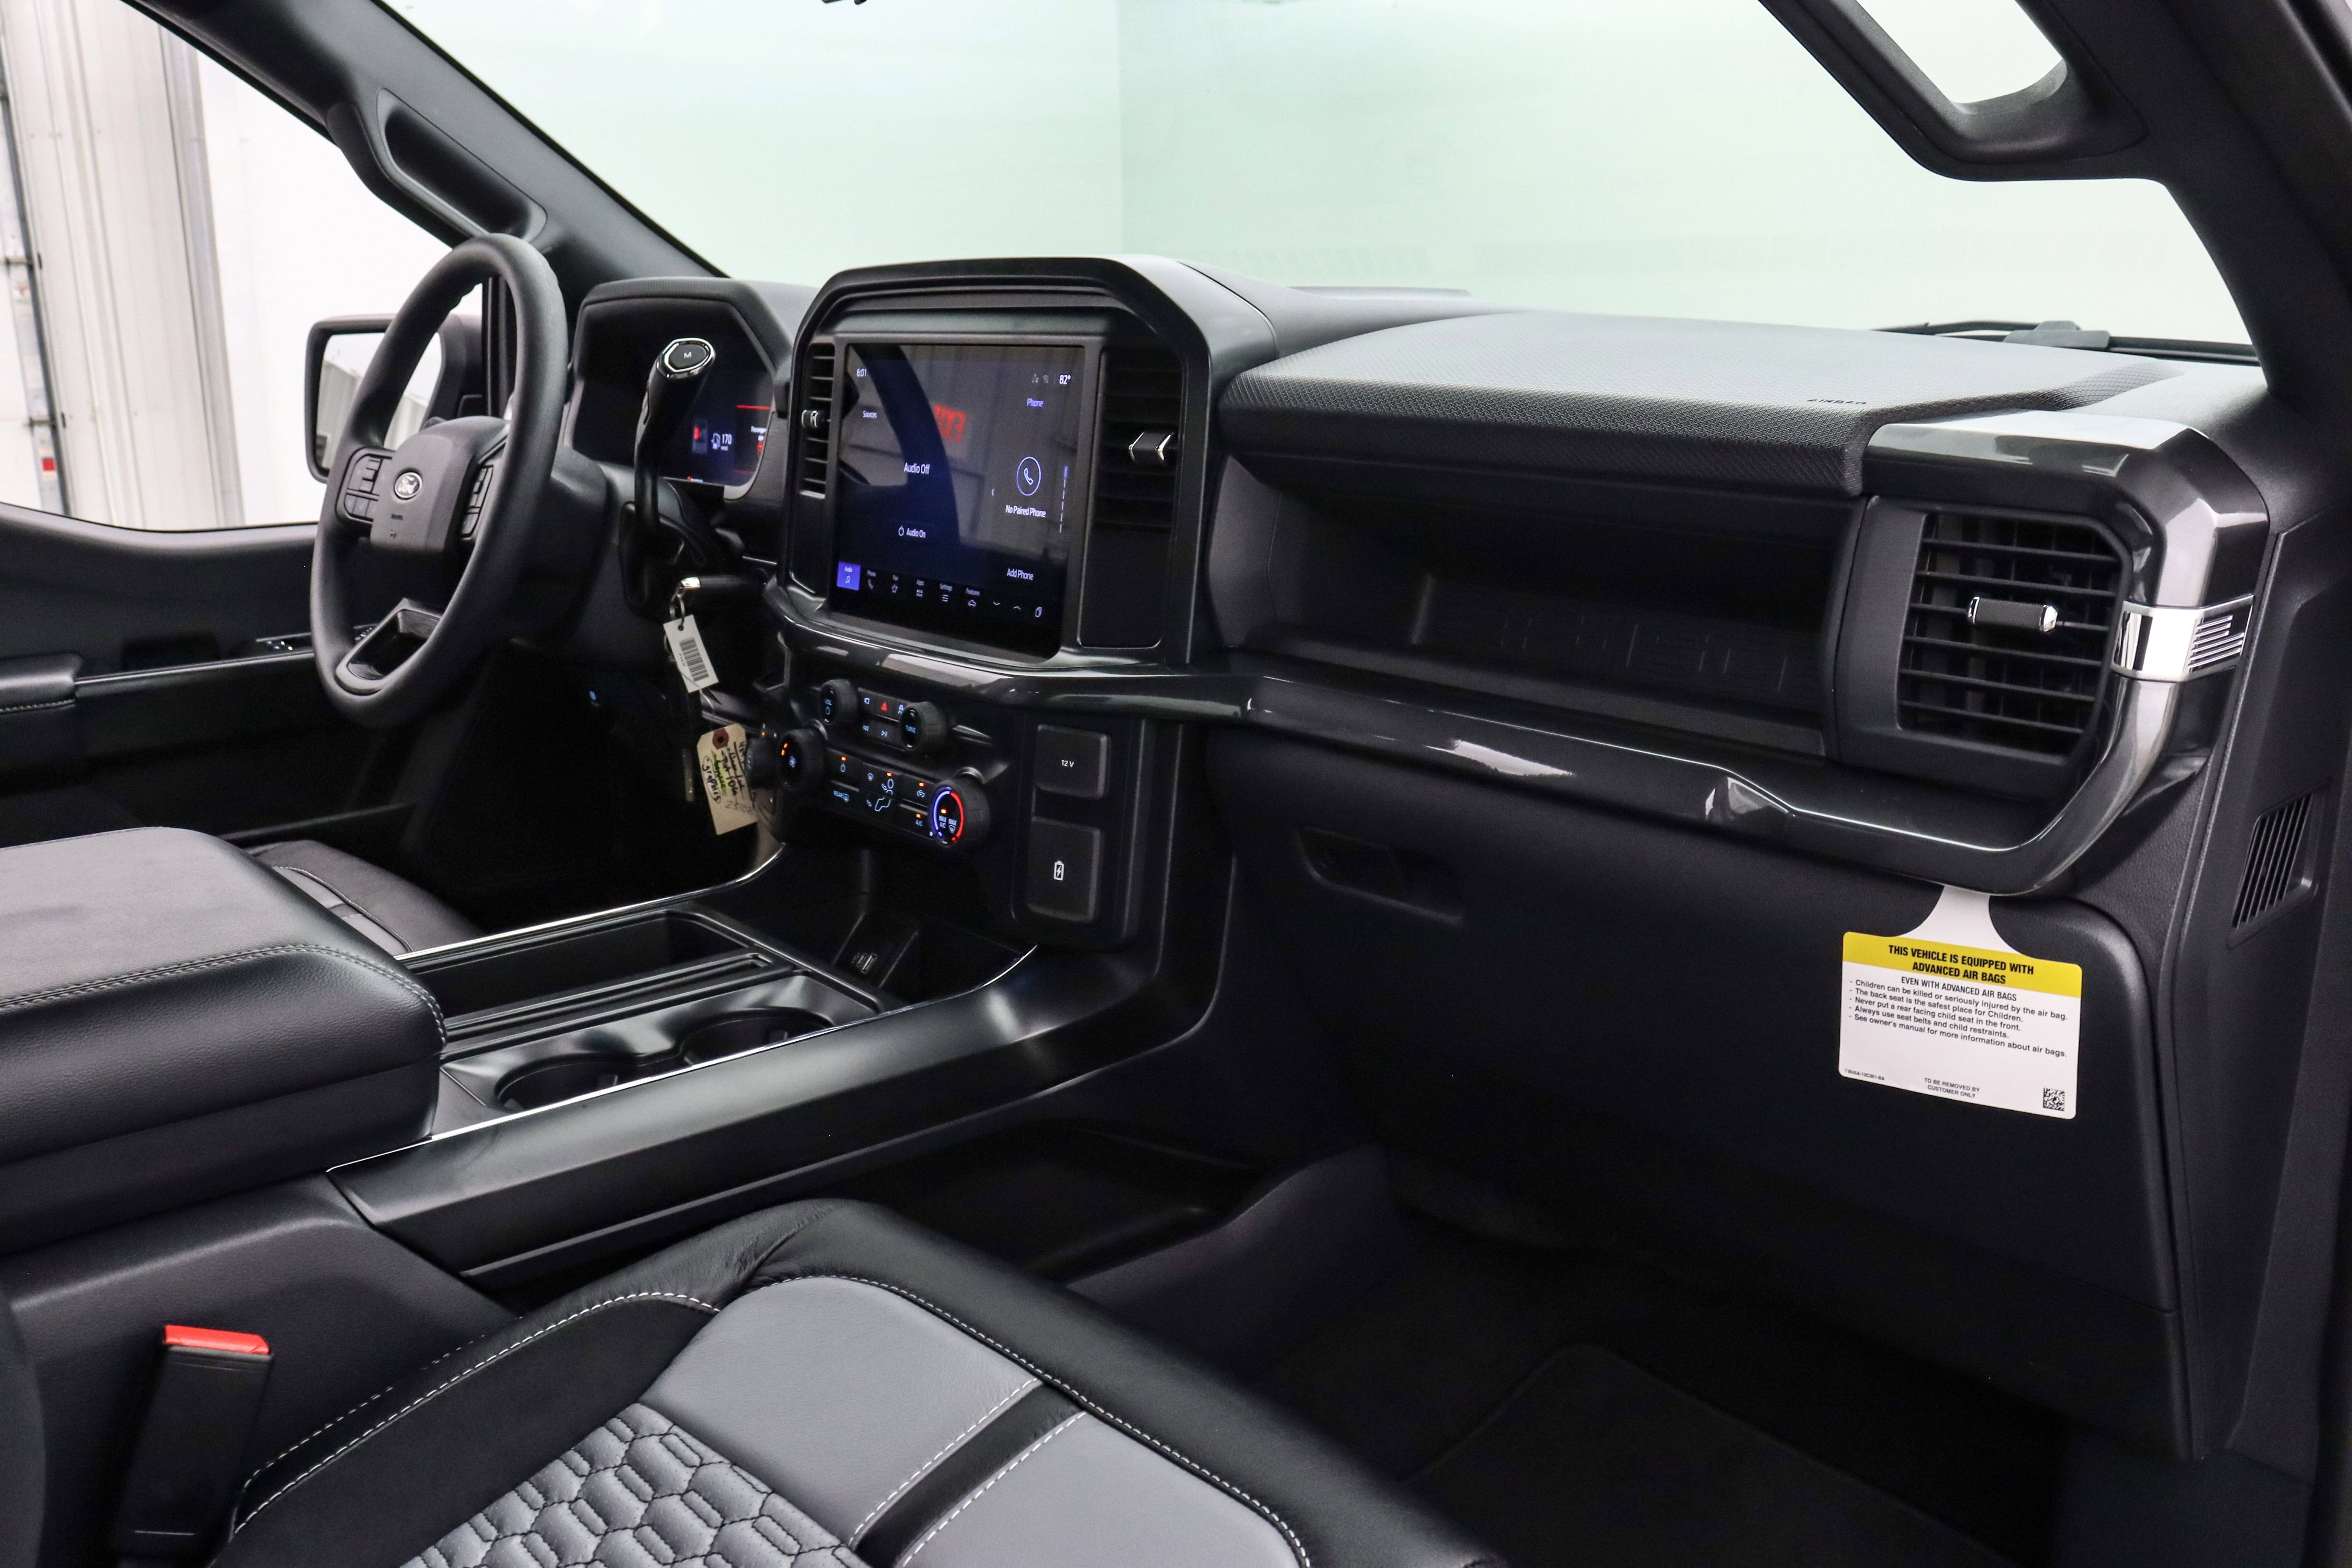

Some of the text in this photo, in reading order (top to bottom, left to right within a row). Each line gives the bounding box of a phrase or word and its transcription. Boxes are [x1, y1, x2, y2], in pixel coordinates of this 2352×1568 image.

[1027, 398, 1044, 407] Phone
[722, 434, 732, 445] 170
[904, 463, 931, 474] Audio Off
[1005, 504, 1047, 517] No Paired Phone
[906, 528, 926, 538] Audio On
[1007, 568, 1034, 580] Add Phone
[1888, 944, 2034, 975] THIS VEHICLE IS EQUIPPED WITH
[1912, 962, 2006, 984] ADVANCED AIR BAGS
[1901, 976, 2017, 1001] EVEN WITH ADVANCED AIR BAGS
[1855, 979, 1885, 990] Children
[1902, 987, 1911, 995] be
[1913, 989, 1933, 998] killed
[1944, 995, 1980, 1007] seriously
[1981, 1000, 2009, 1011] injured
[2011, 1004, 2021, 1014] by
[2022, 1007, 2036, 1015] the
[2050, 1011, 2067, 1021] bag.
[1855, 987, 1869, 998] The
[1870, 990, 1887, 1000] back
[1914, 998, 1926, 1006] the
[1928, 1001, 1950, 1010] safest
[1952, 1005, 1973, 1014] place
[1974, 1006, 1986, 1016] for
[1987, 1009, 2023, 1022] Children.
[1854, 1005, 1880, 1016] Always
[1913, 1016, 1931, 1025] belts
[1932, 1017, 1947, 1028] and
[1949, 1022, 1968, 1031] child
[1969, 1027, 2009, 1038] restraints.
[1855, 996, 1875, 1007] Never
[1913, 1007, 1936, 1018] facing
[1937, 1011, 1956, 1020] child
[1985, 1019, 1998, 1027] the
[2000, 1021, 2020, 1031] front.
[1854, 1013, 1867, 1022] See
[1869, 1018, 1897, 1027] owner's
[1898, 1023, 1925, 1033] manual
[1927, 1027, 1938, 1035] for
[1939, 1031, 1959, 1039] more
[1960, 1033, 2005, 1047] information
[2007, 1042, 2030, 1051] about
[2045, 1047, 2067, 1057] bags.
[1927, 1085, 1959, 1095] CUSTOMER
[1942, 1081, 1970, 1091] REMOVED
